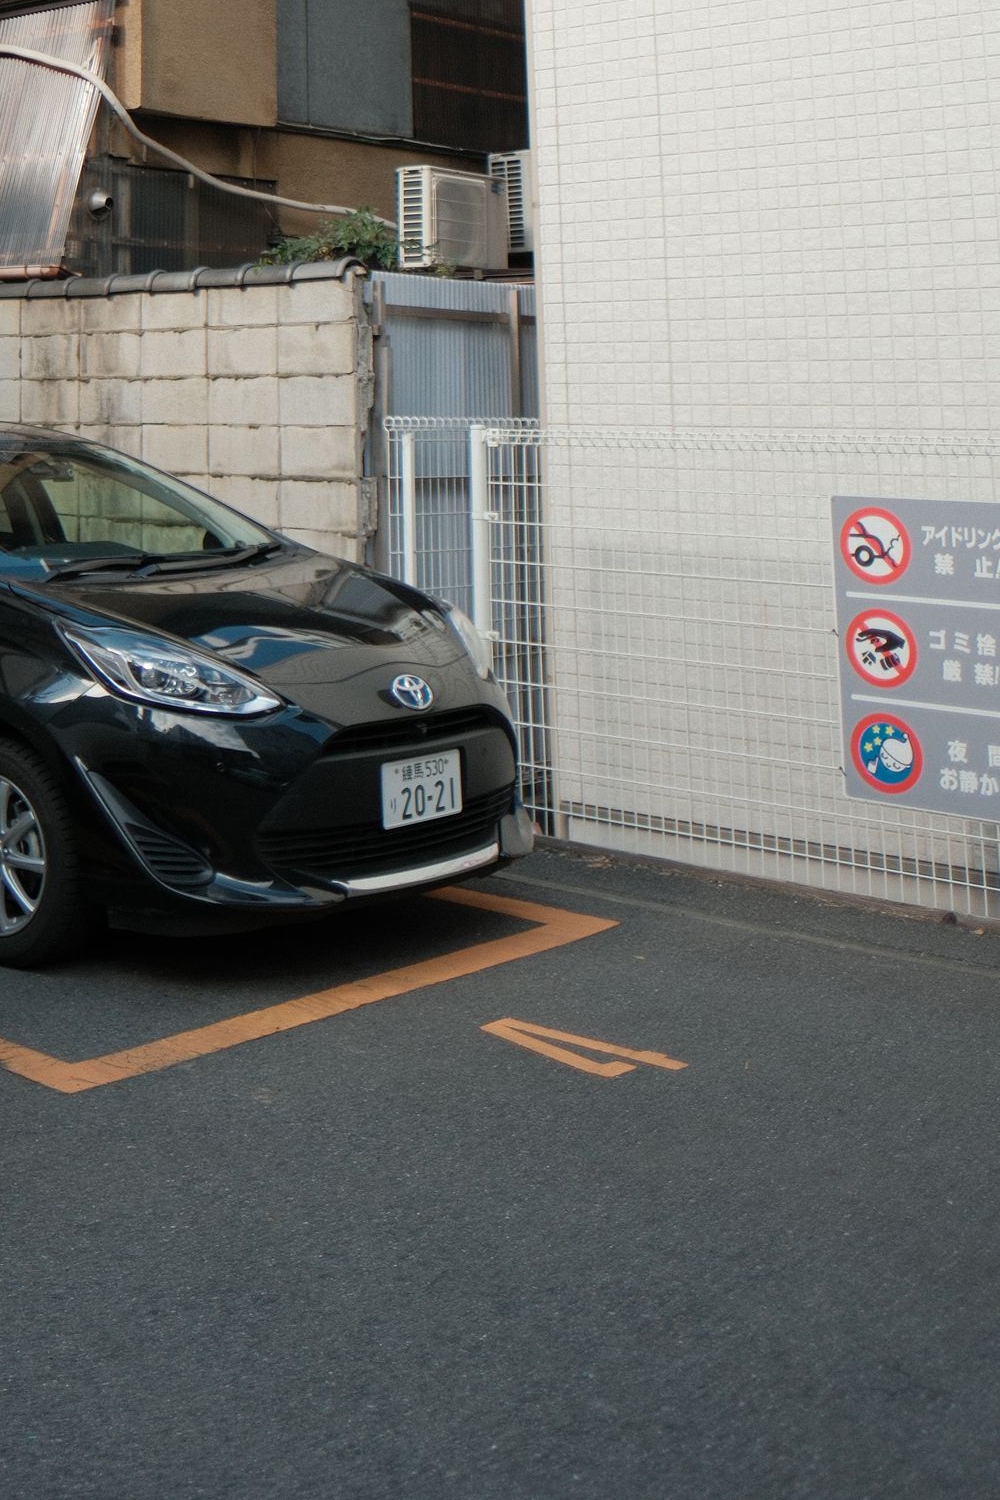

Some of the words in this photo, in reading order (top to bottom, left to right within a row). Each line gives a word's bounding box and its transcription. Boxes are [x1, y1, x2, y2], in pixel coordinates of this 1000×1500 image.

[928, 629, 996, 657] ゴミ捨
[401, 777, 455, 820] 20-21
[940, 768, 999, 796] お静か
[479, 1017, 689, 1078] 4
